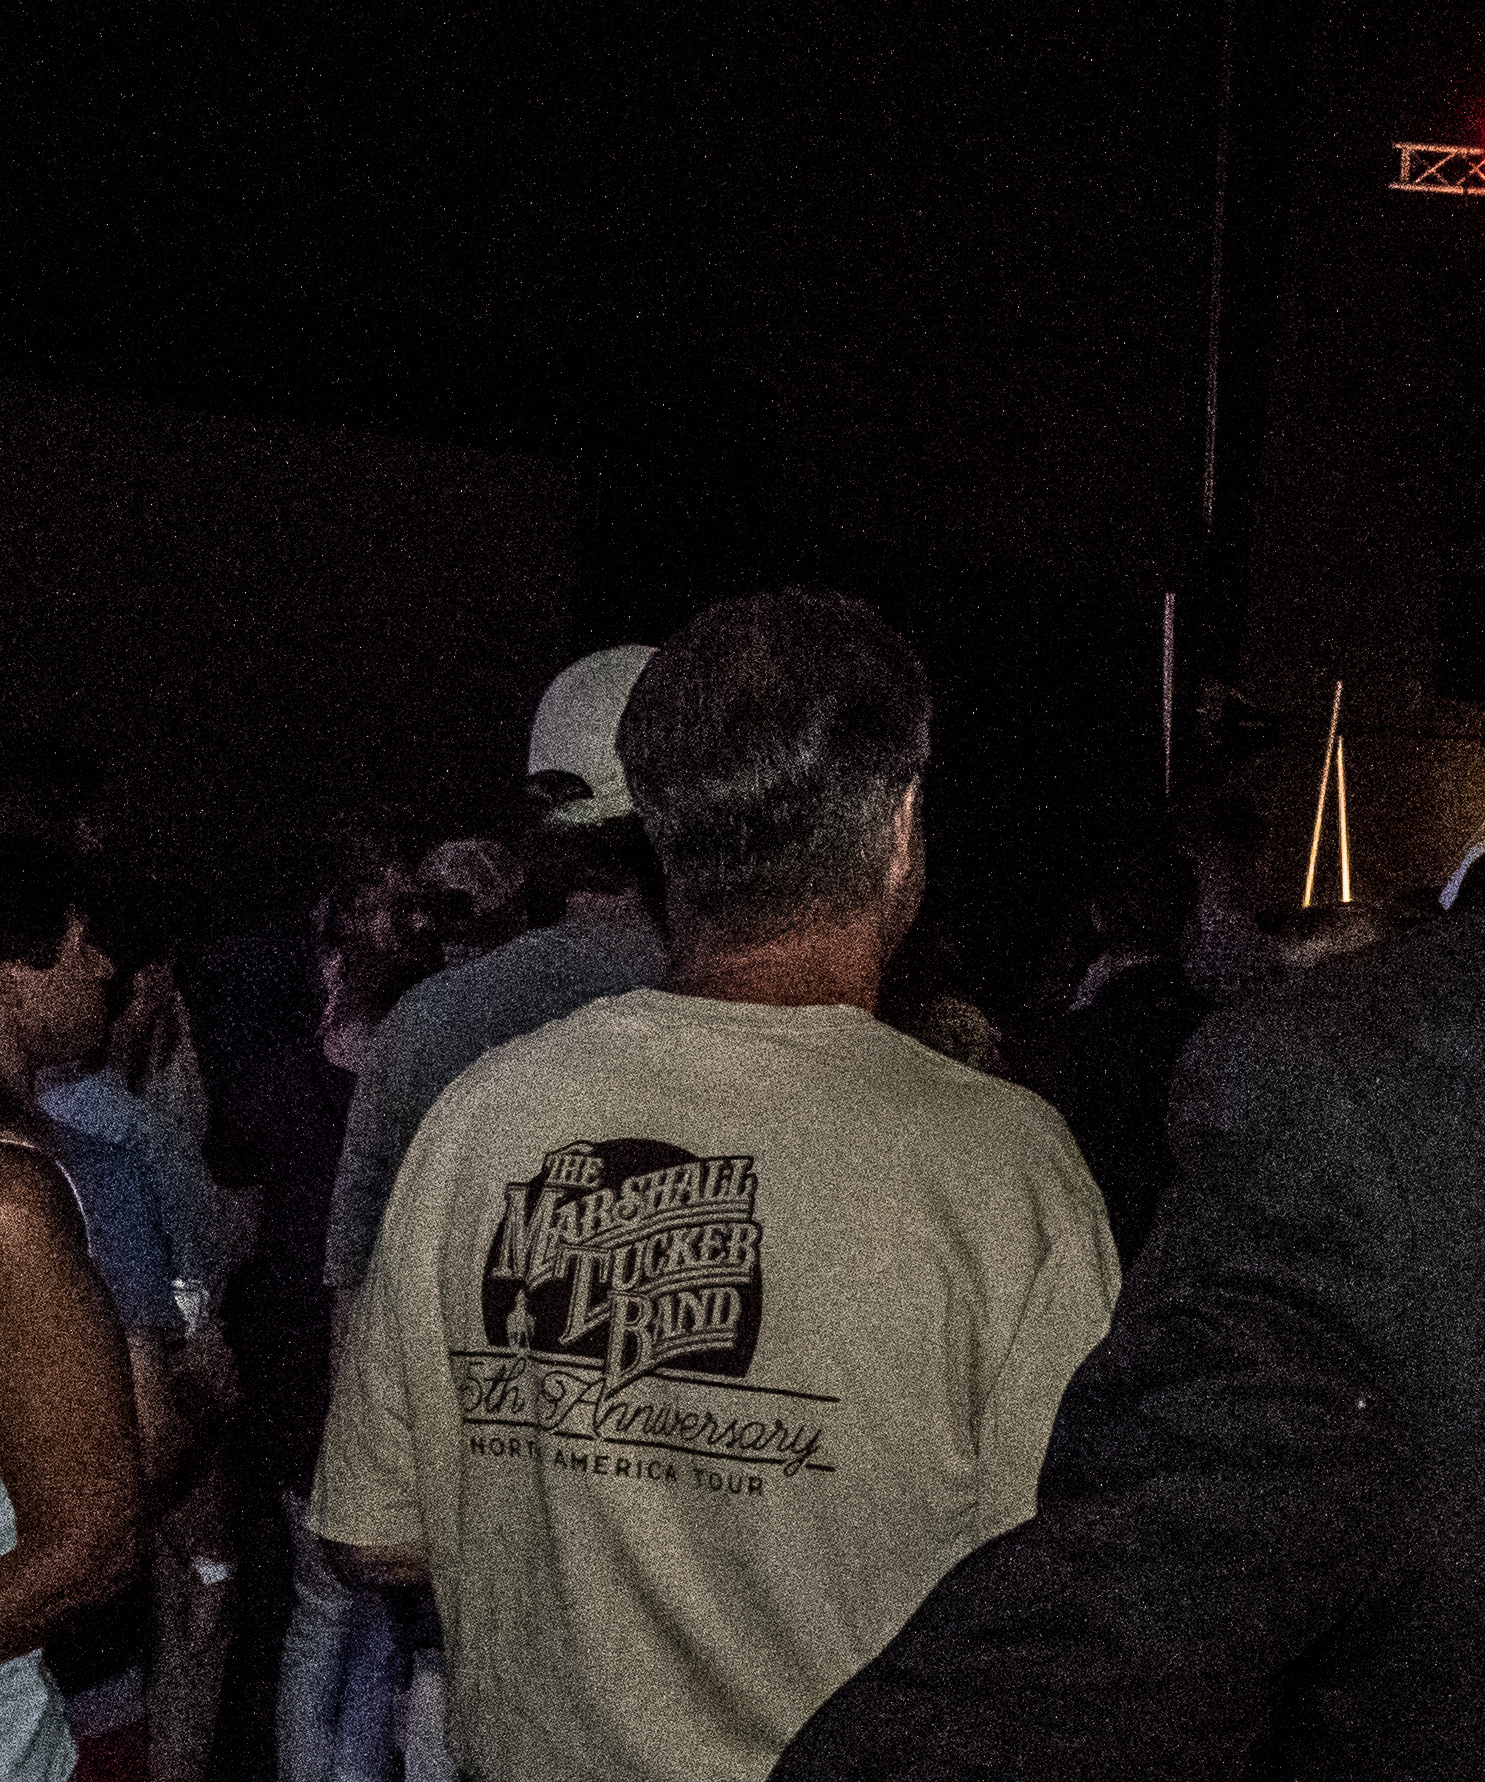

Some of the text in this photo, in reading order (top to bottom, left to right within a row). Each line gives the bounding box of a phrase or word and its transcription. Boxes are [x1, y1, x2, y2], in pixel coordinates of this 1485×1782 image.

[493, 1156, 757, 1281] MARSHALL
[546, 1152, 607, 1189] THE
[558, 1223, 761, 1345] TUCKER
[604, 1287, 744, 1397] BAND
[470, 1437, 765, 1494] NORT AMERICA TOUR
[541, 1370, 823, 1477] Anniversary
